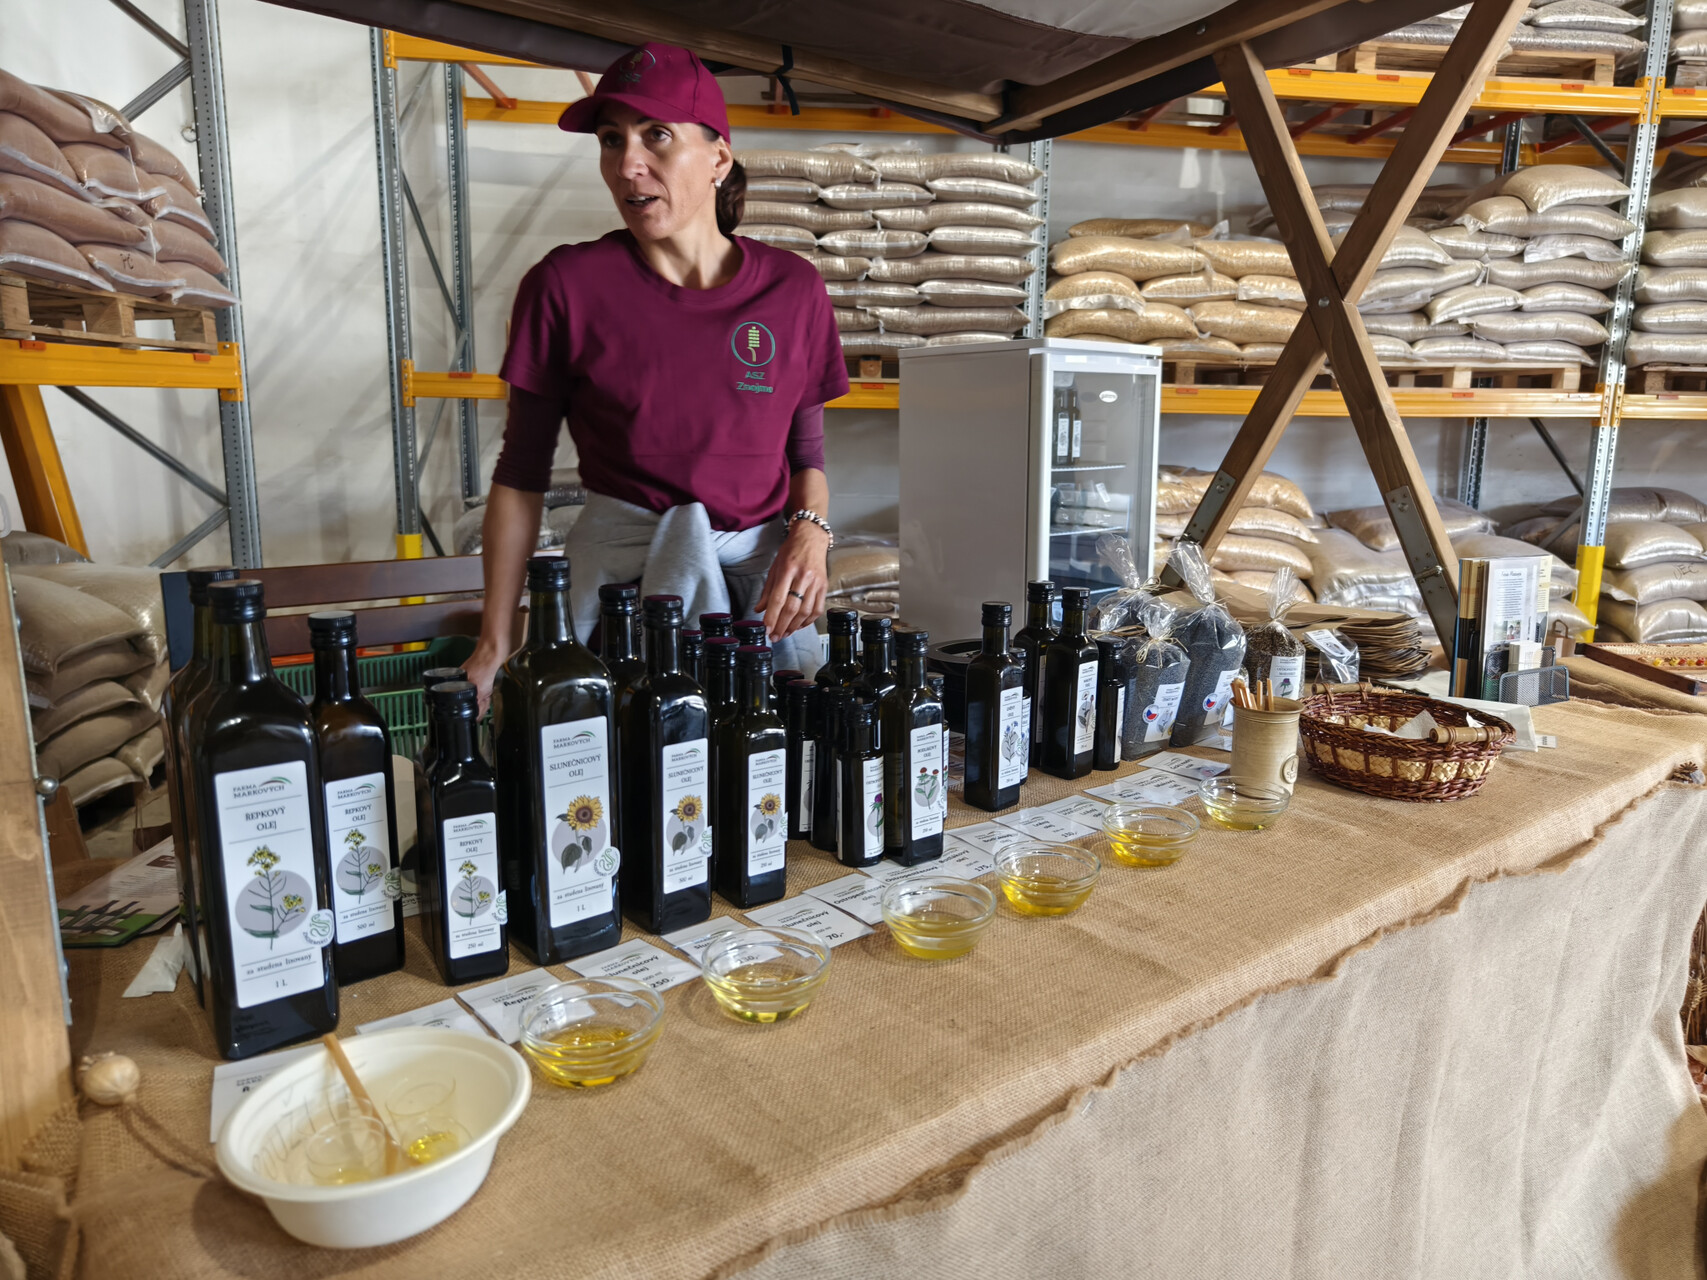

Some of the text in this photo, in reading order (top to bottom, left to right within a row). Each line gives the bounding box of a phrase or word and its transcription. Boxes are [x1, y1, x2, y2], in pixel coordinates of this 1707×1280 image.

[745, 371, 766, 380] ASZ
[549, 754, 602, 771] SLUNEČNICOVÝ
[568, 769, 584, 778] OLEJ
[233, 784, 257, 793] FARMA
[233, 783, 285, 799] MARKOVÝCH
[245, 805, 286, 821] ŘEPKOVÝ
[352, 814, 366, 822] OLEJ
[256, 821, 277, 831] OLEJ
[806, 920, 822, 928] olej
[825, 931, 845, 941] 70,-
[257, 961, 283, 973] studena
[285, 953, 312, 965] lisovaný
[631, 966, 650, 976] olej
